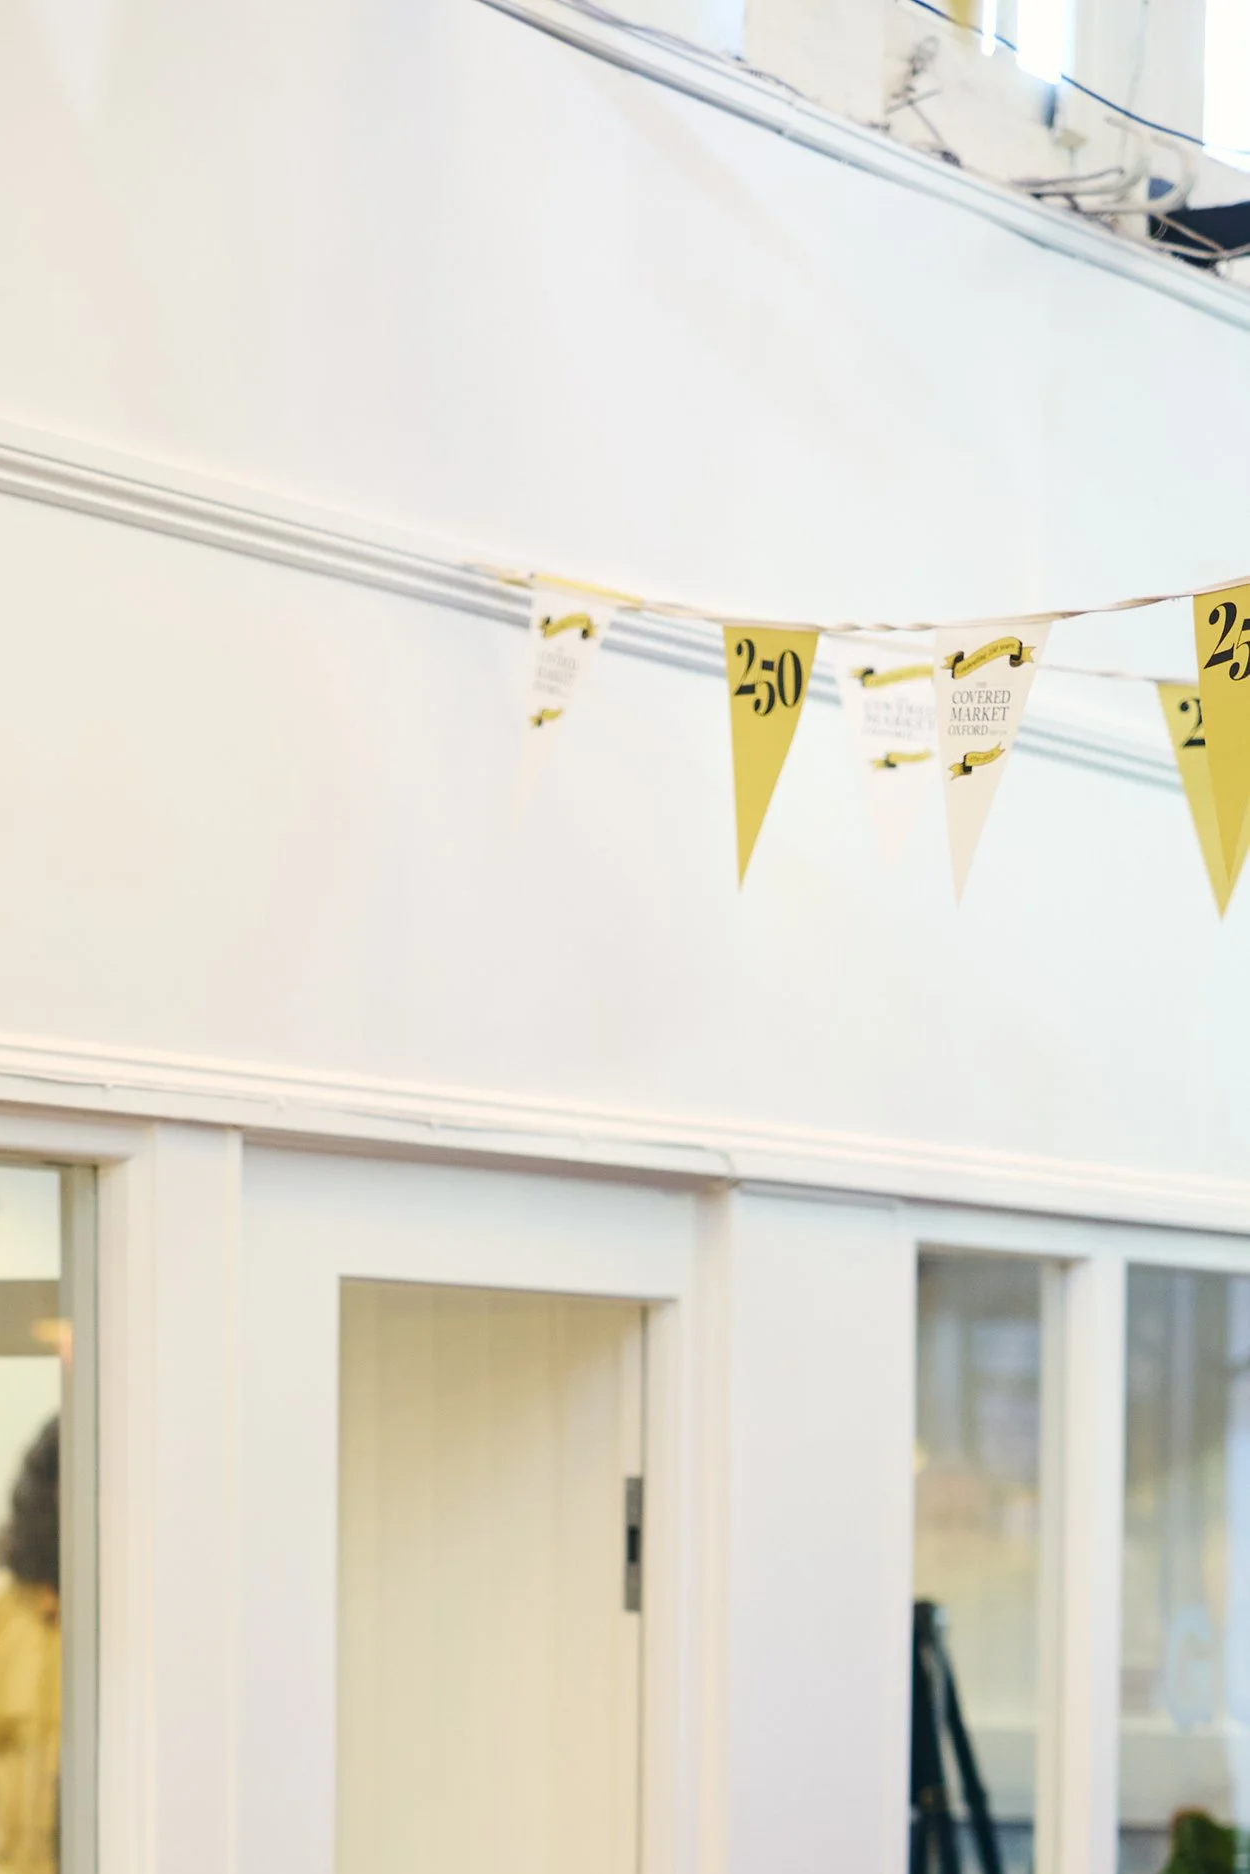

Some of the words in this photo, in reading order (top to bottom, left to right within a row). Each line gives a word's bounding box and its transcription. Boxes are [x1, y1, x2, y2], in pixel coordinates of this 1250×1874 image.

[734, 638, 803, 716] 250
[951, 689, 1011, 705] COVERED
[949, 706, 1010, 722] MARKET
[947, 724, 989, 736] OXFORD
